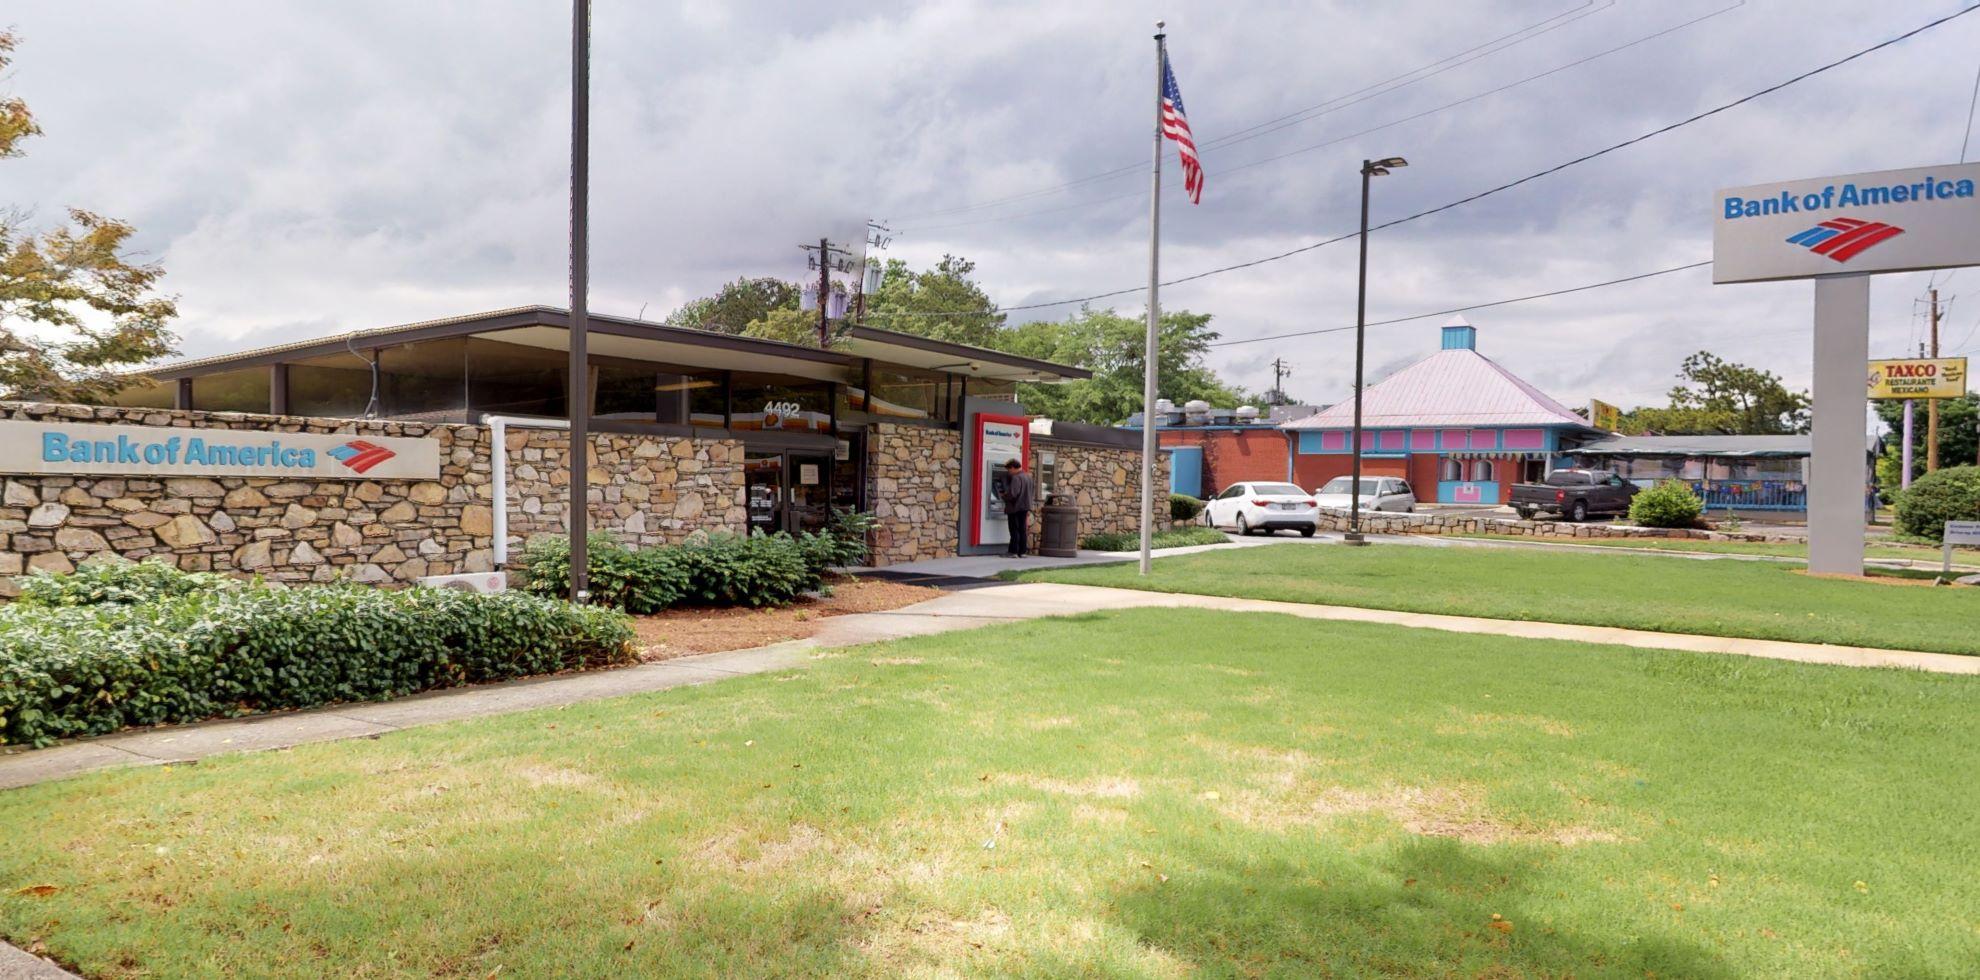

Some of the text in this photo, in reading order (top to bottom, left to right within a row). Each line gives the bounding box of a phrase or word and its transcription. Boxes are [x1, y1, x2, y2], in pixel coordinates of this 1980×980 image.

[1724, 177, 1974, 219] Bank of America
[1885, 364, 1936, 377] TAXCO
[764, 401, 800, 419] 4492
[42, 432, 316, 468] Bank of America
